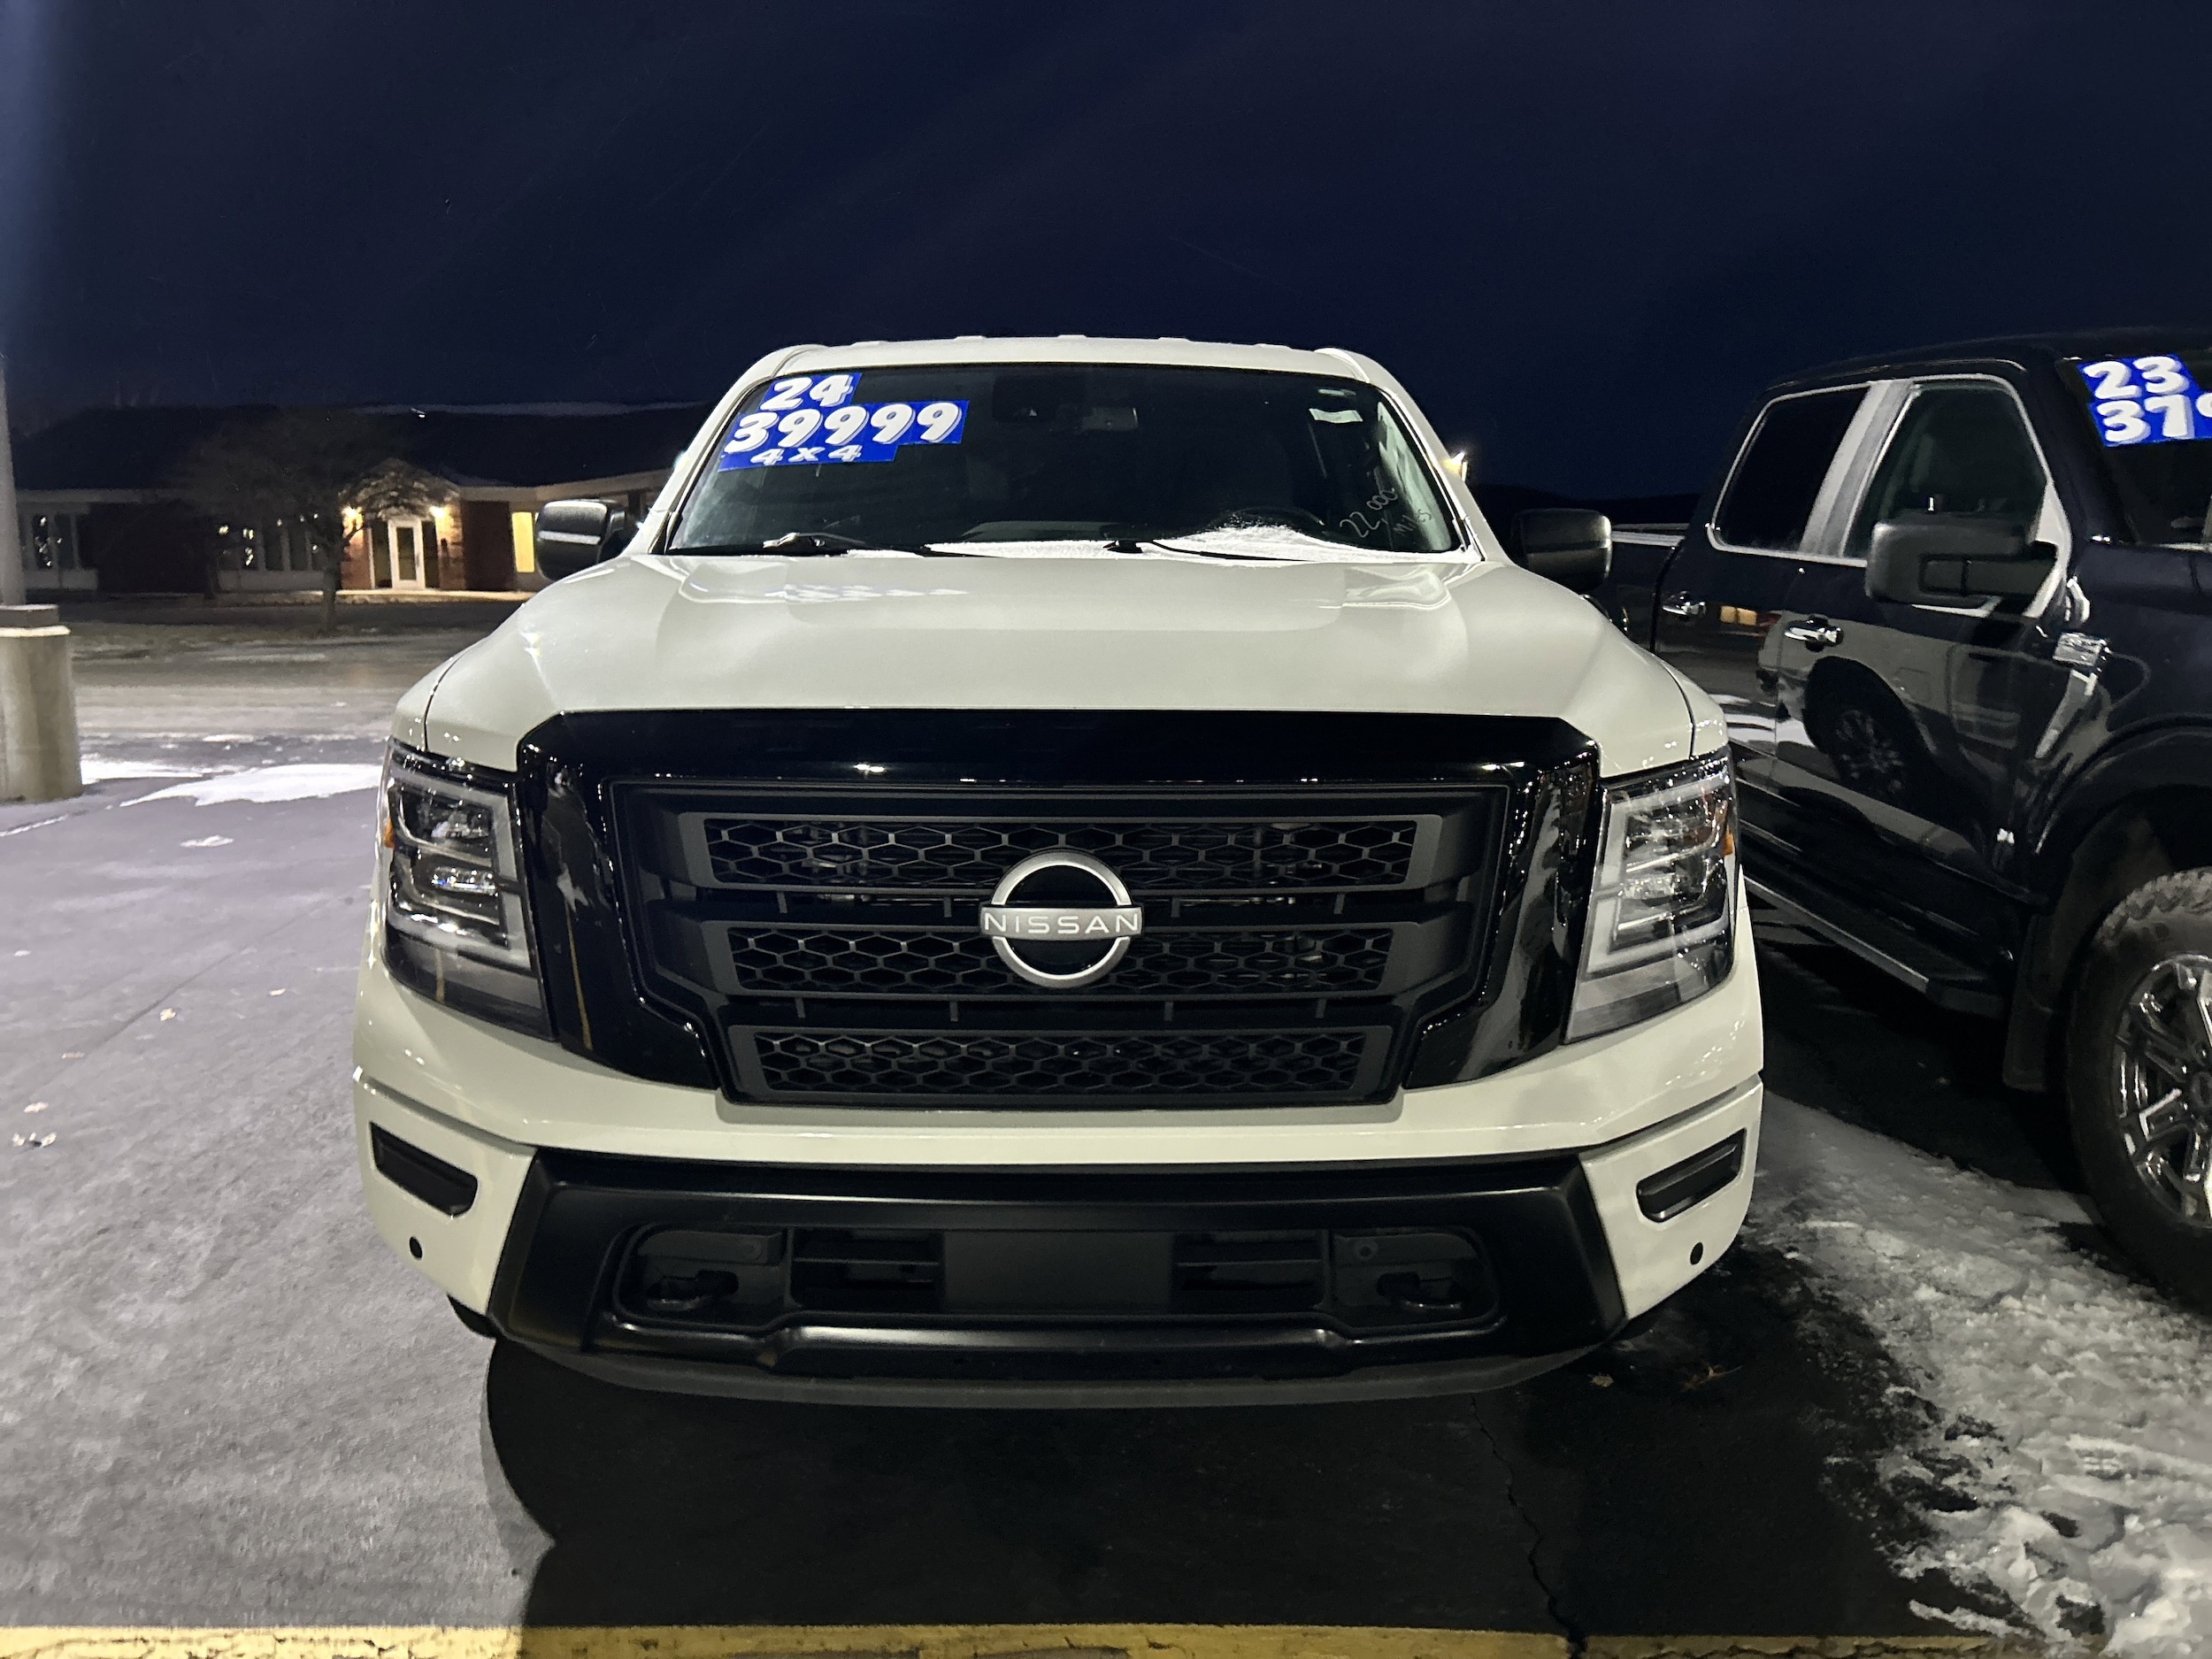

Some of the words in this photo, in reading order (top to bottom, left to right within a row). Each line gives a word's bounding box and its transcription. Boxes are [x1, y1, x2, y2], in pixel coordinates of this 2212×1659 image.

[759, 374, 853, 411] 24
[2083, 356, 2190, 400] 23
[724, 402, 963, 454] 39999
[982, 911, 1139, 934] NISSAN
